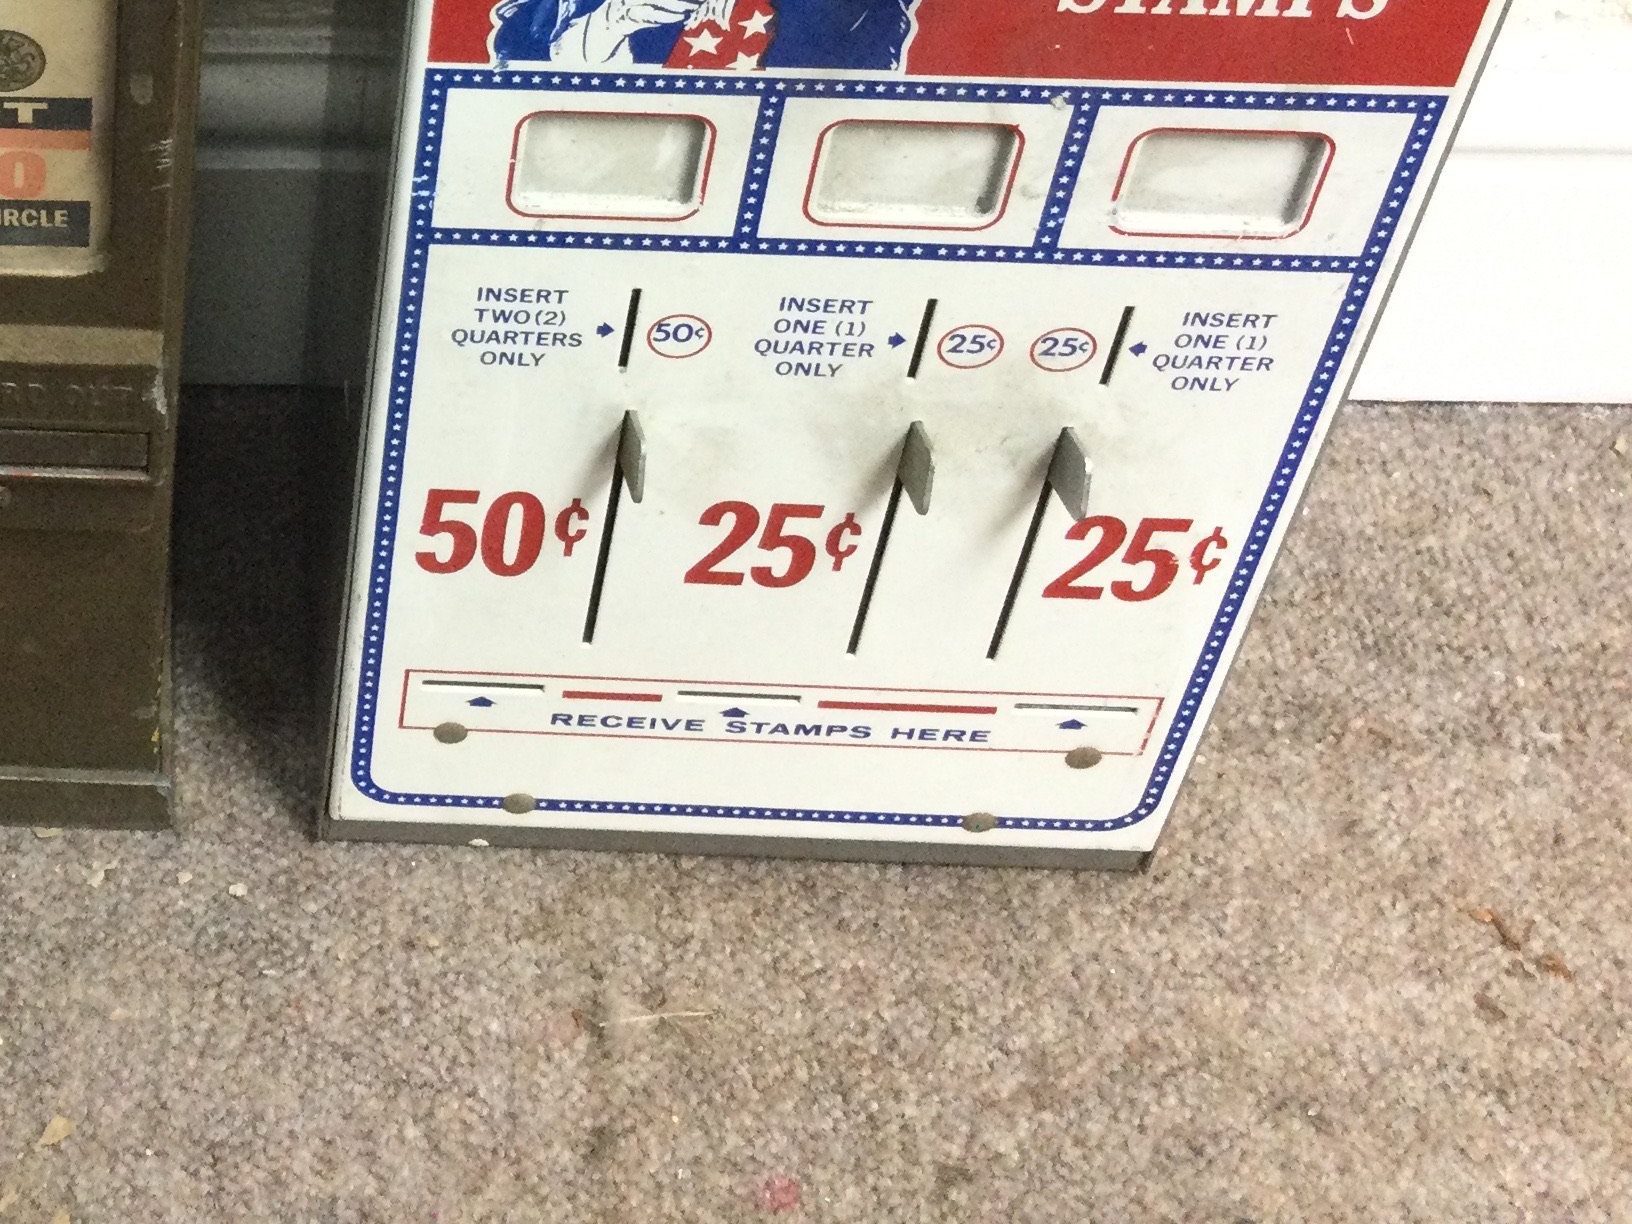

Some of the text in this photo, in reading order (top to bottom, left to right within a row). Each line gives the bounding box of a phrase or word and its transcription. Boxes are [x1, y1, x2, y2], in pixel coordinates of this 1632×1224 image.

[476, 286, 569, 306] INSERT
[778, 296, 875, 316] INSERT
[773, 318, 828, 336] ONE
[1181, 311, 1278, 331] INSERT
[450, 328, 583, 348] QUARTERS
[753, 337, 876, 359] QUARTER
[1173, 333, 1229, 351] ONE
[479, 351, 547, 368] ONLY
[774, 360, 844, 379] ONLY
[1151, 352, 1275, 373] QUARTER
[1170, 374, 1240, 392] ONLY
[549, 711, 992, 744] RECEIVE STAMPS HERE
